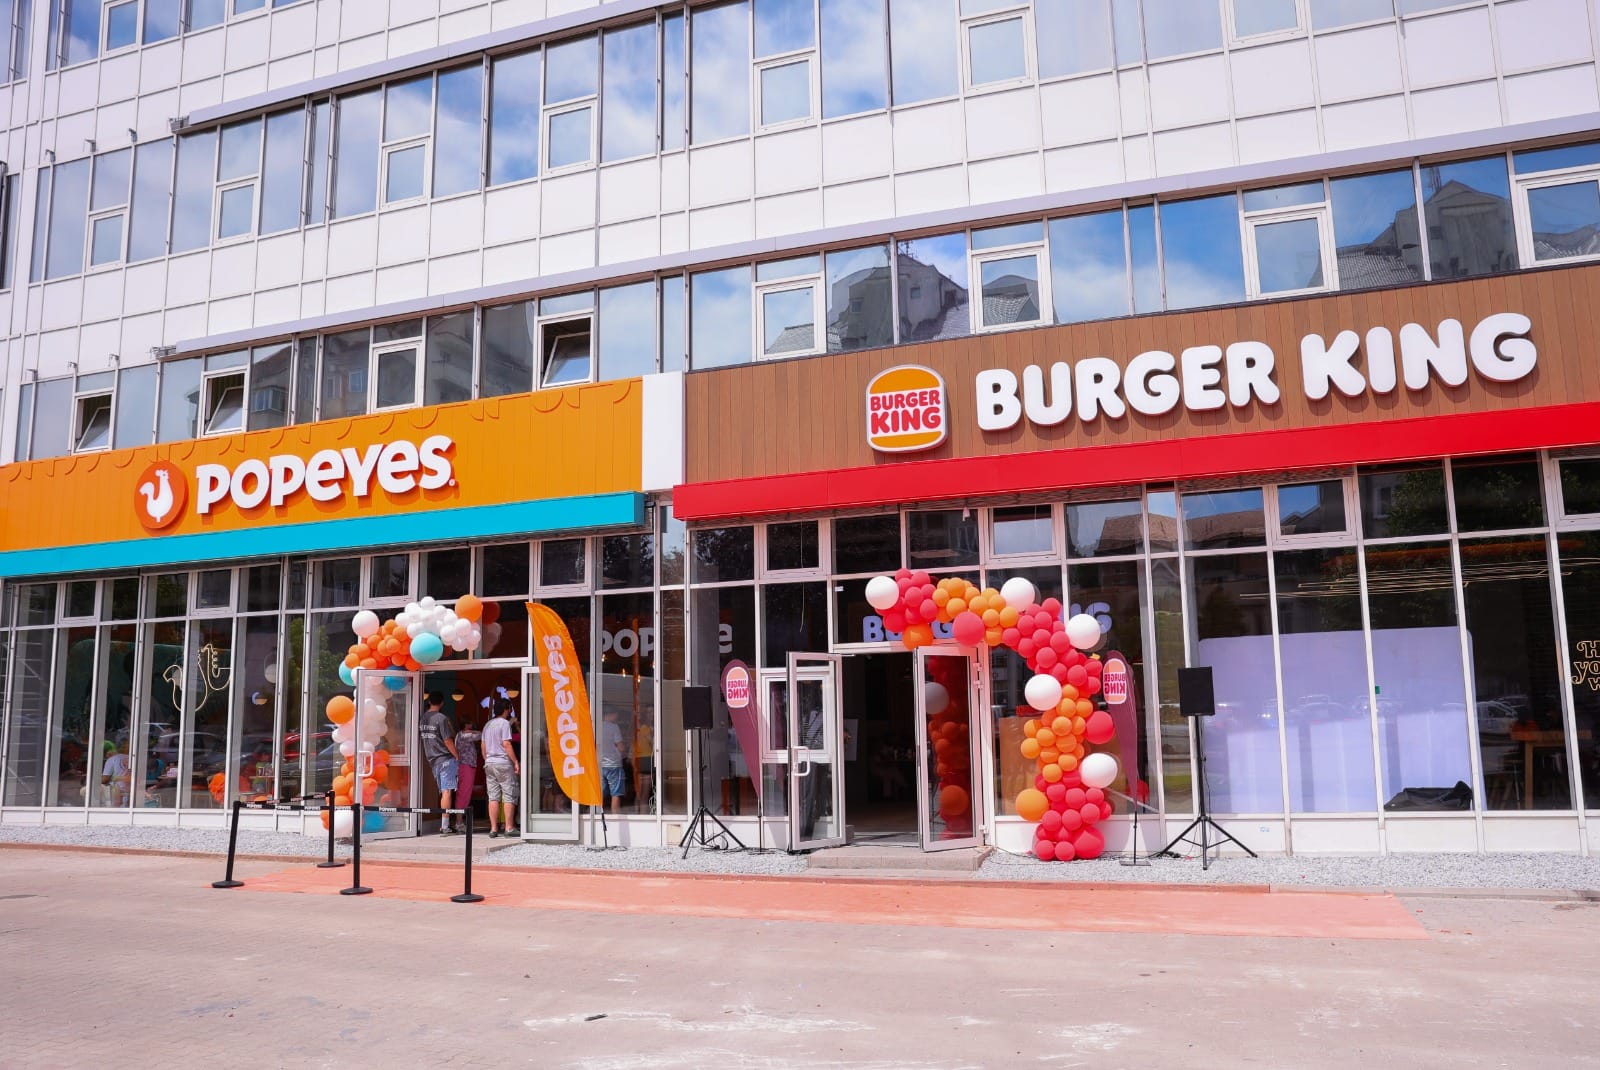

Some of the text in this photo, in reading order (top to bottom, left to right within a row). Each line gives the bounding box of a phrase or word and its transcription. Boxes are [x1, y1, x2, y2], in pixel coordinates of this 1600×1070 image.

[975, 312, 1538, 431] BURGER KING
[870, 389, 941, 412] BURGER
[870, 406, 942, 435] KING
